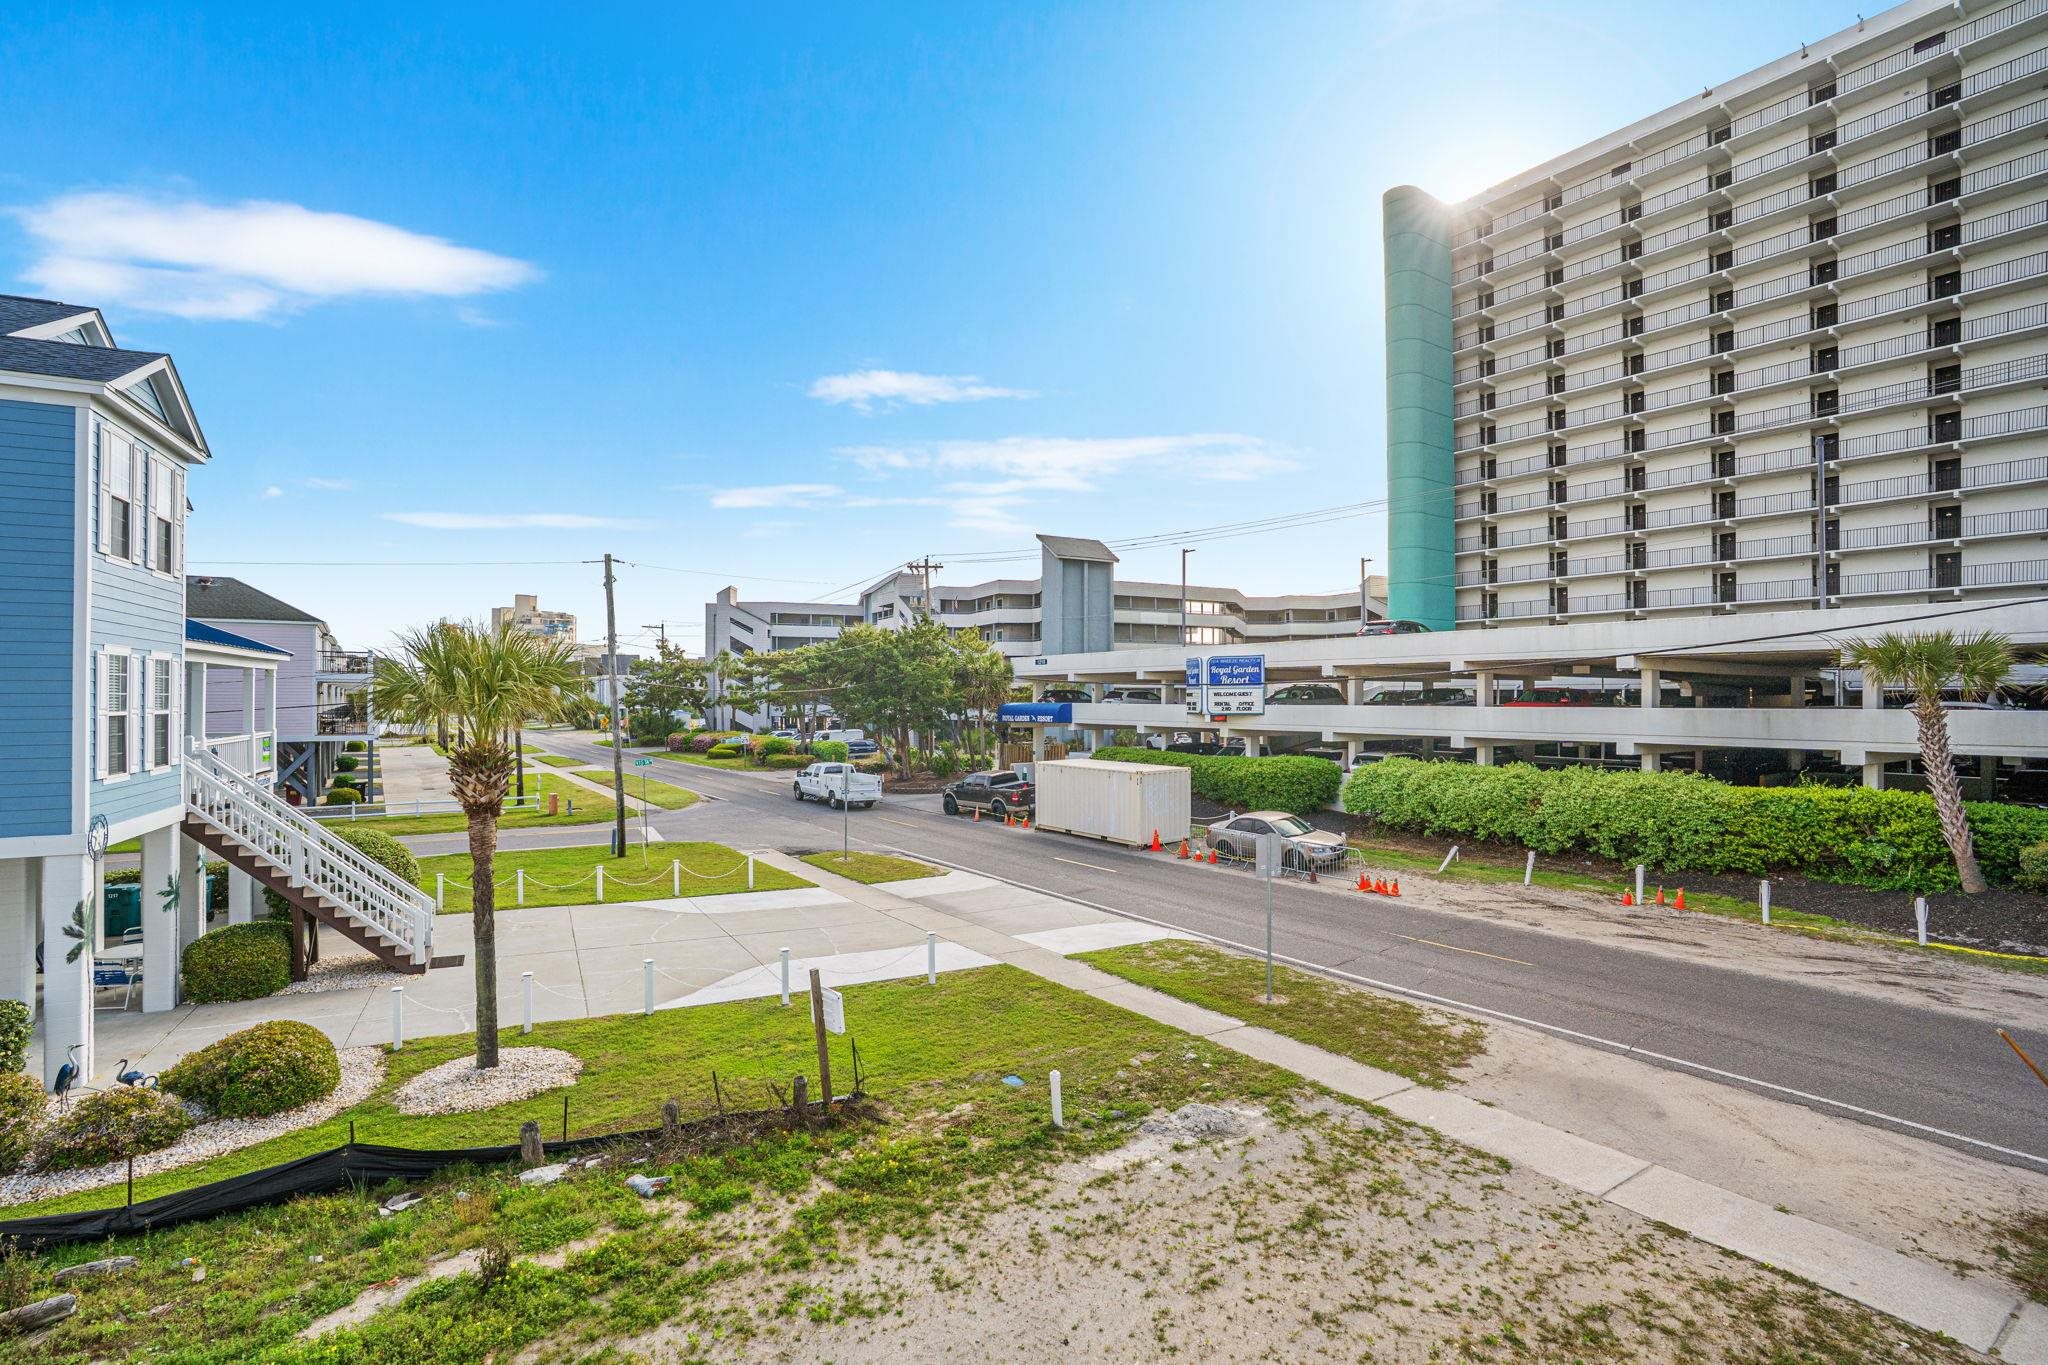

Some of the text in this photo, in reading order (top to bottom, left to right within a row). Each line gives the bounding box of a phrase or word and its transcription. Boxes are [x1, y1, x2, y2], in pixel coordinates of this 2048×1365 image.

[1210, 665, 1232, 675] Royal
[1232, 665, 1259, 674] Garden
[1220, 675, 1249, 684] Resort
